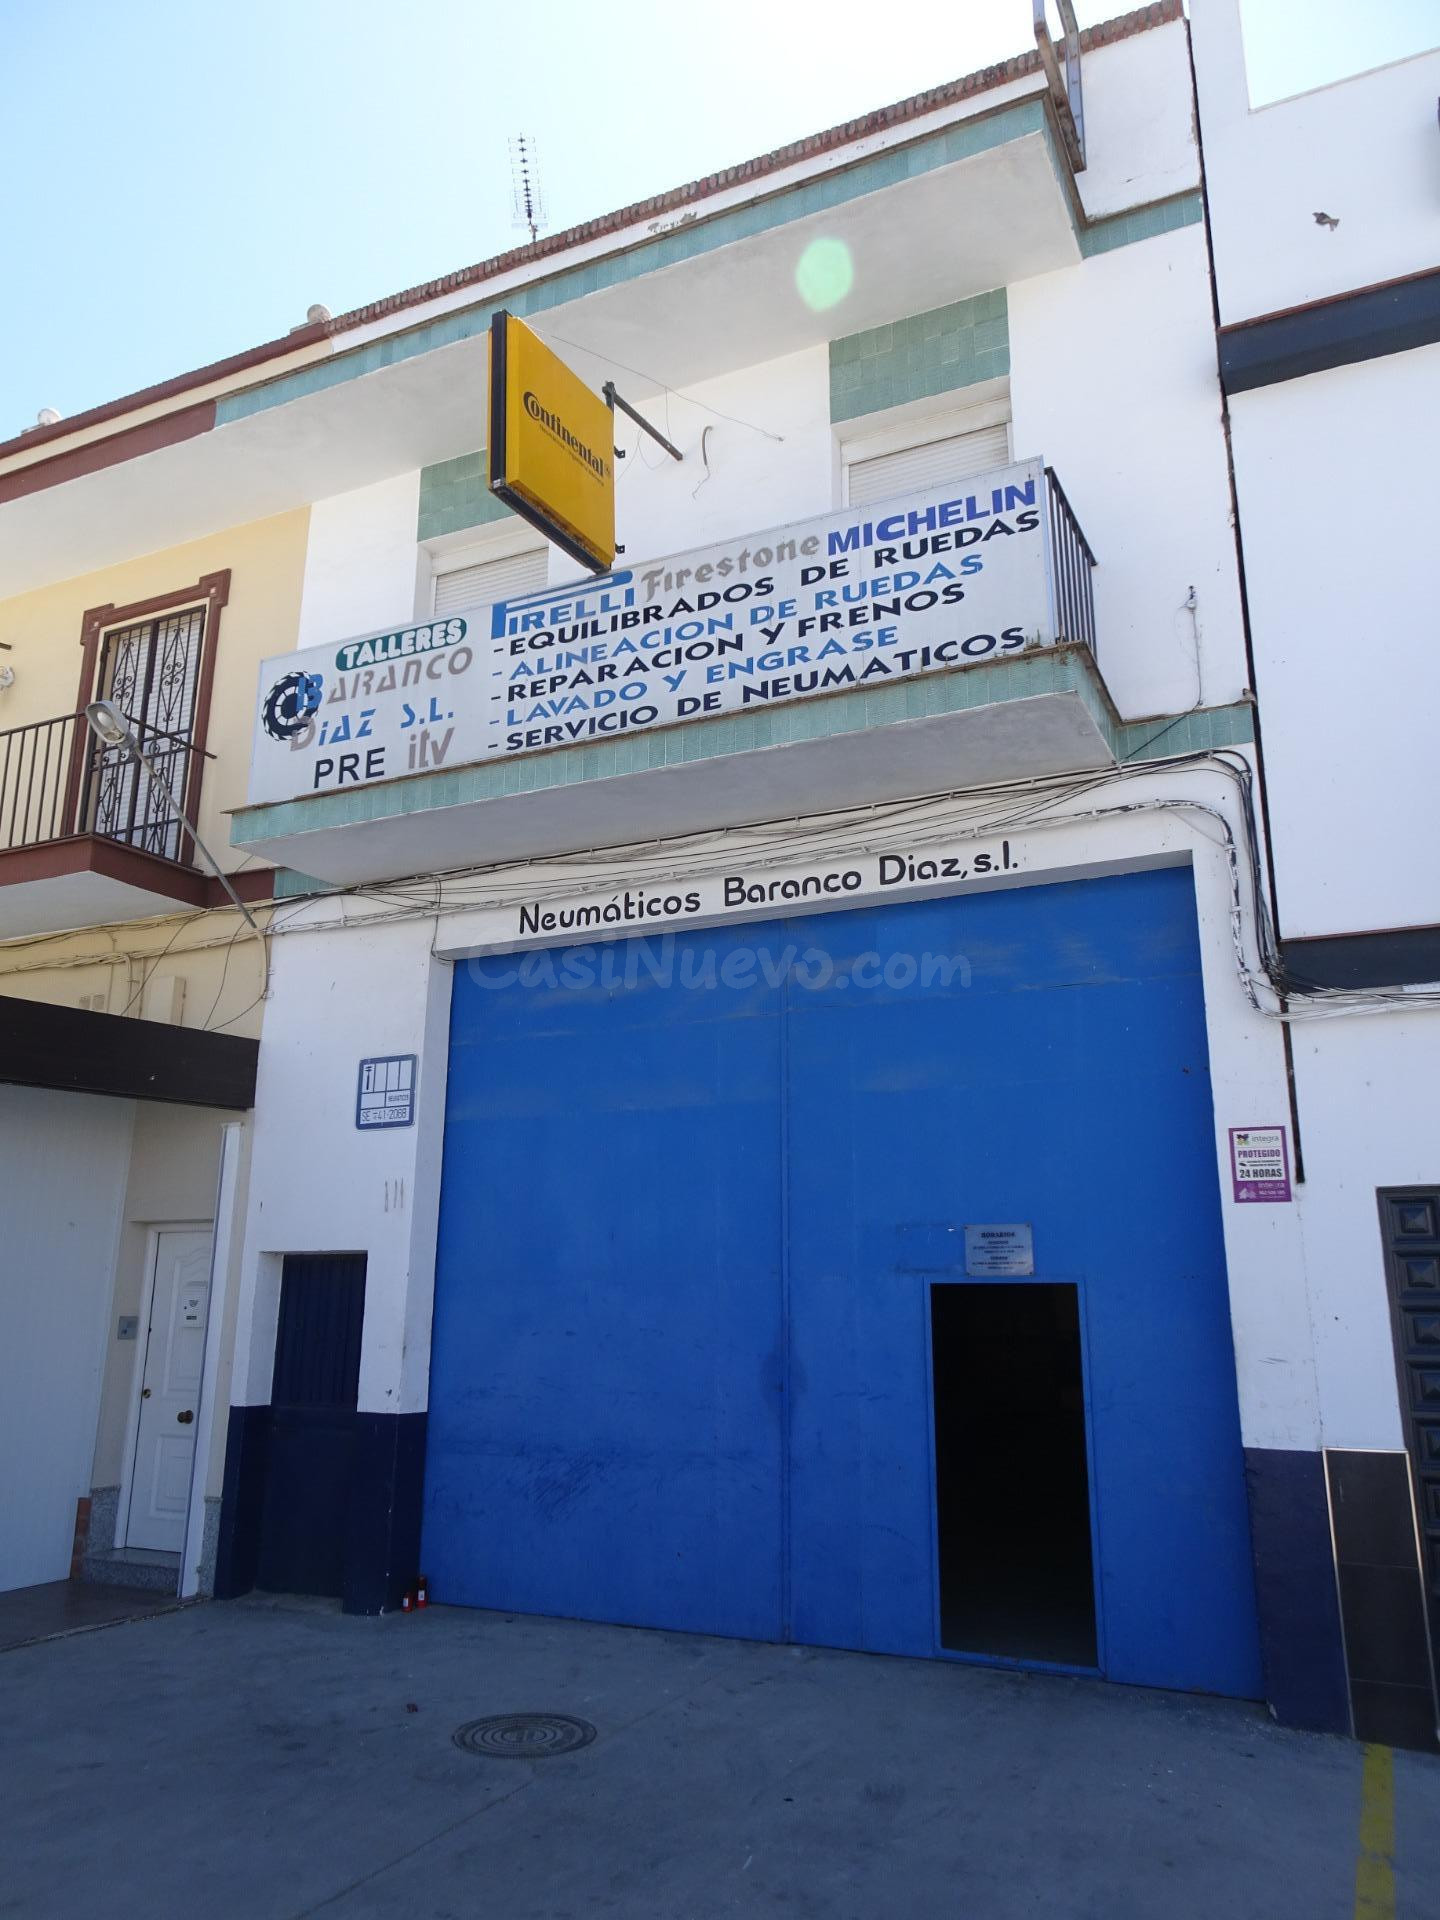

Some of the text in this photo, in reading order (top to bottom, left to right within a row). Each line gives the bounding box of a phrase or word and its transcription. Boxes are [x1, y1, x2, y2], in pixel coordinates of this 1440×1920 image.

[523, 391, 604, 477] Continental
[801, 558, 850, 586] DE
[874, 510, 1040, 568] RUEDAS
[828, 479, 1036, 556] MICHELIN
[641, 535, 820, 602] Firestone
[750, 599, 798, 626] DE
[815, 554, 984, 611] RUEDAS
[491, 570, 635, 640] PIRELLI
[759, 622, 785, 645] Y
[798, 583, 965, 638] FRENOS
[342, 619, 463, 670] TALLERES
[662, 670, 688, 692] Y
[706, 626, 899, 685] ENGRASE
[677, 690, 722, 717] DE
[743, 627, 1025, 704] NEUMATICOS
[313, 746, 386, 789] PRE
[518, 891, 701, 935] Neumáticos
[724, 871, 862, 907] Baranco
[1238, 1149, 1281, 1158] PROTEGIDO
[1240, 1168, 1282, 1178] 24 HORAS
